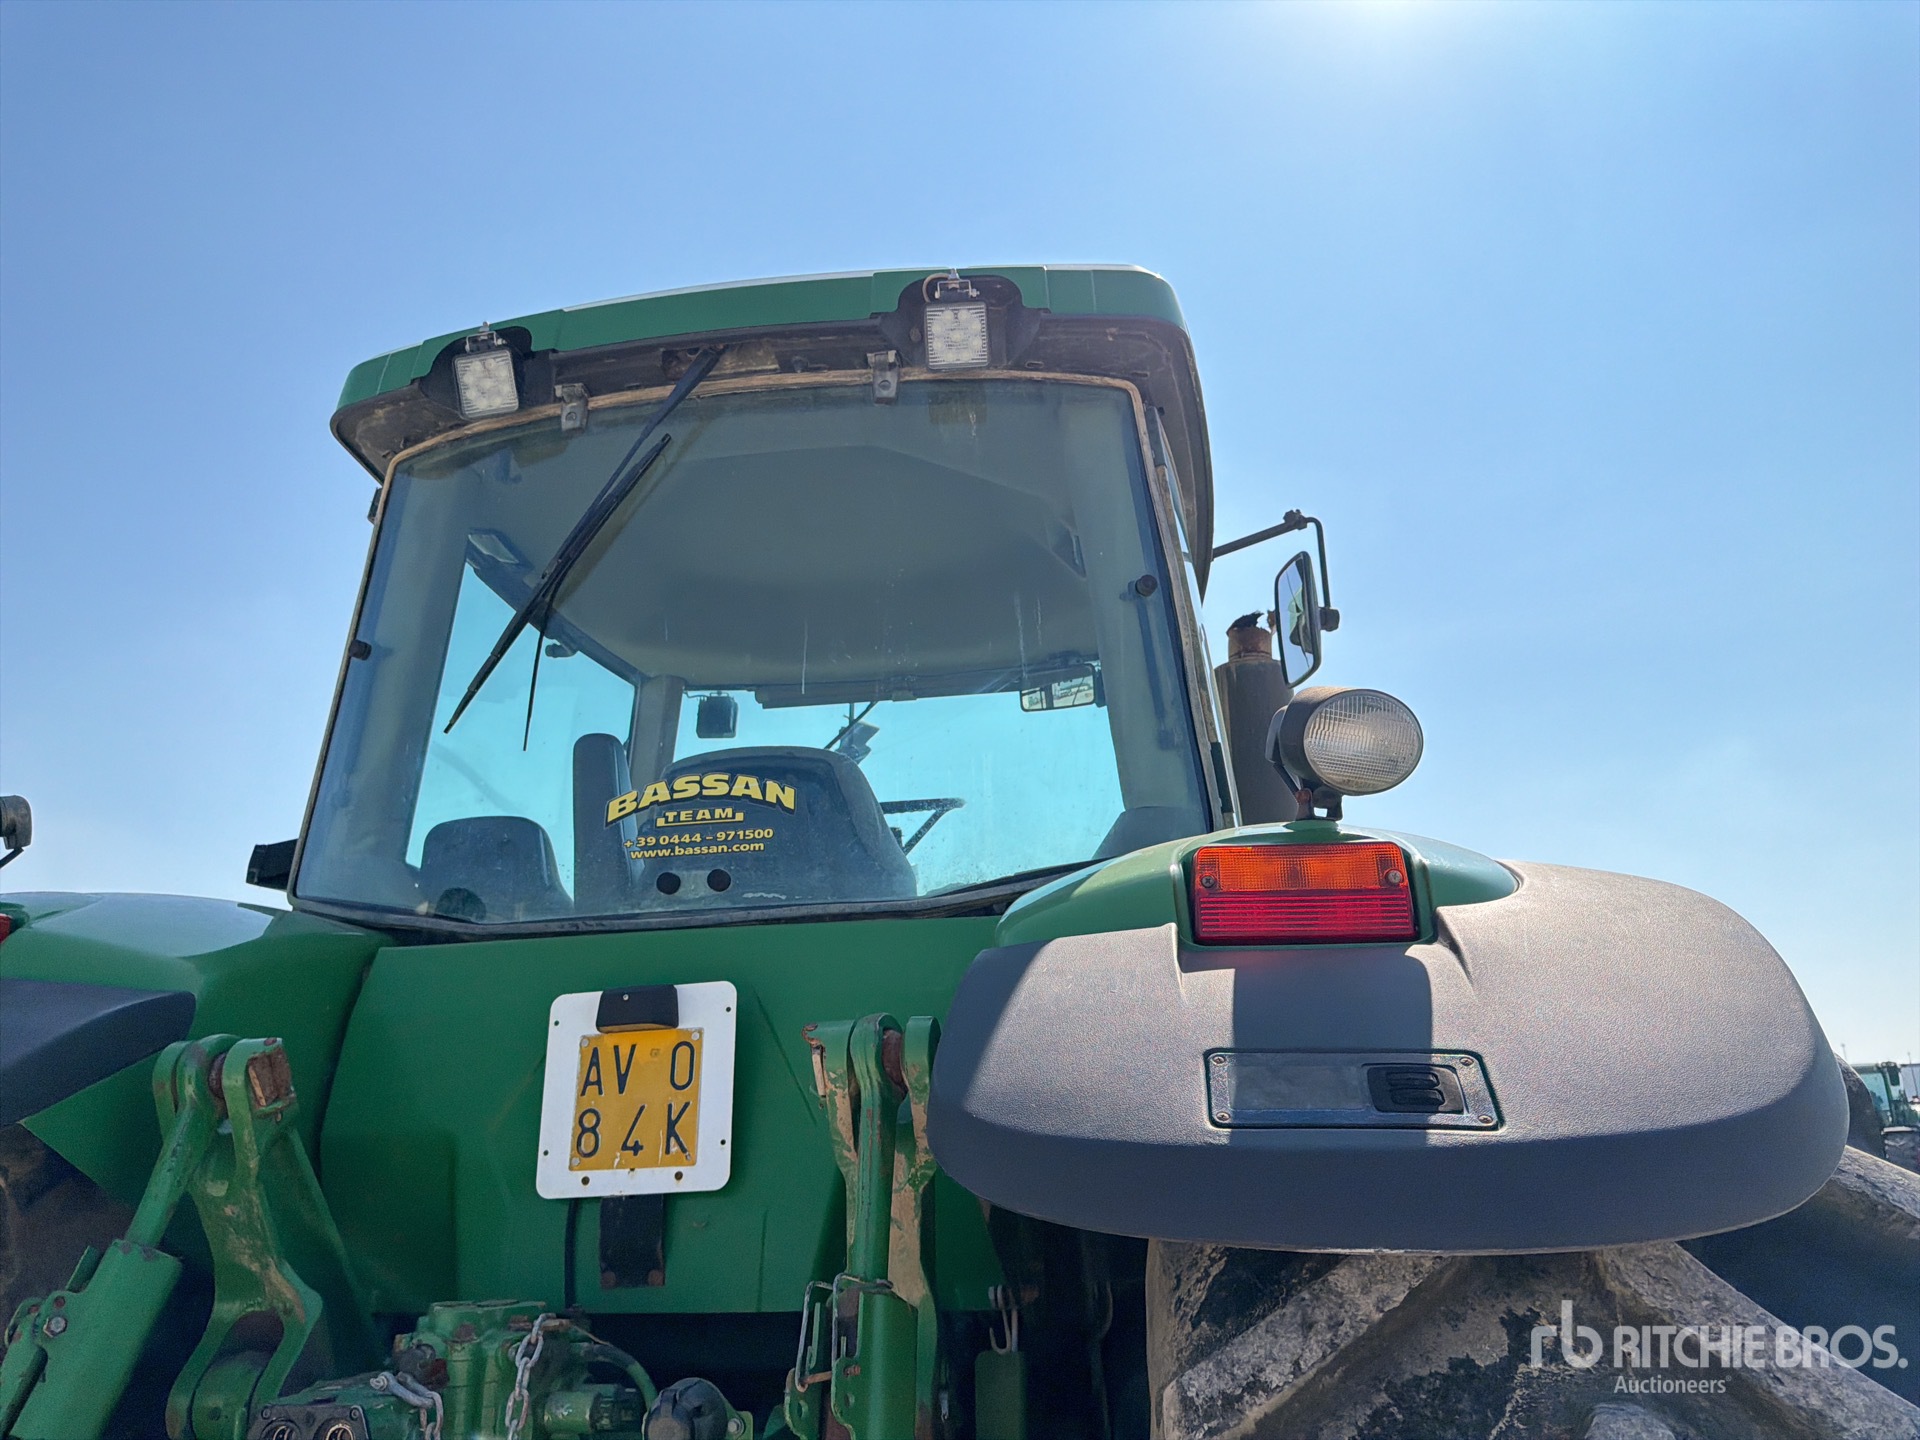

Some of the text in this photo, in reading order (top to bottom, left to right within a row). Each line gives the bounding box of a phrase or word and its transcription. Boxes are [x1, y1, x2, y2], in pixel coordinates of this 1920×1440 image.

[605, 773, 796, 825] BASSAN
[665, 808, 733, 823] TEAM
[659, 833, 701, 845] 0444
[716, 828, 774, 842] 971500
[630, 842, 765, 859] www.bassan.com
[580, 1044, 637, 1096] AV
